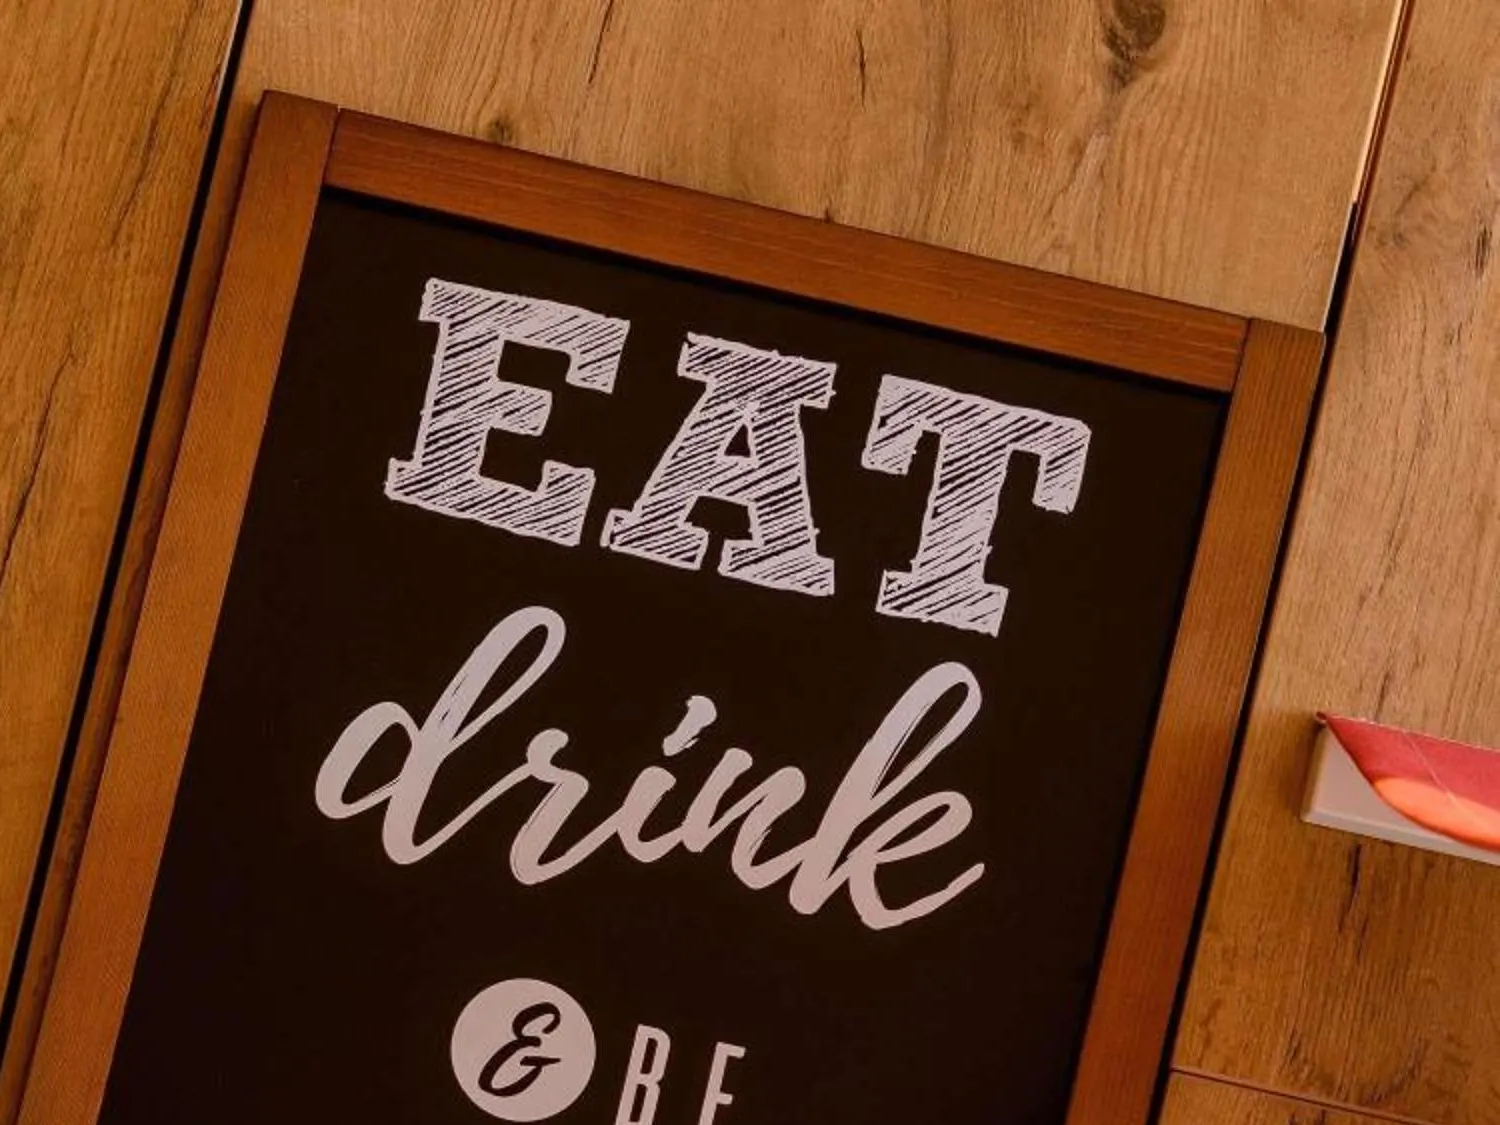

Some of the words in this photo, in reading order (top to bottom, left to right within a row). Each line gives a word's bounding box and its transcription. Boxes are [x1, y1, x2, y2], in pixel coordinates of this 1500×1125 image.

[384, 278, 1092, 637] EAT
[315, 606, 985, 931] drink
[477, 1001, 562, 1098] &
